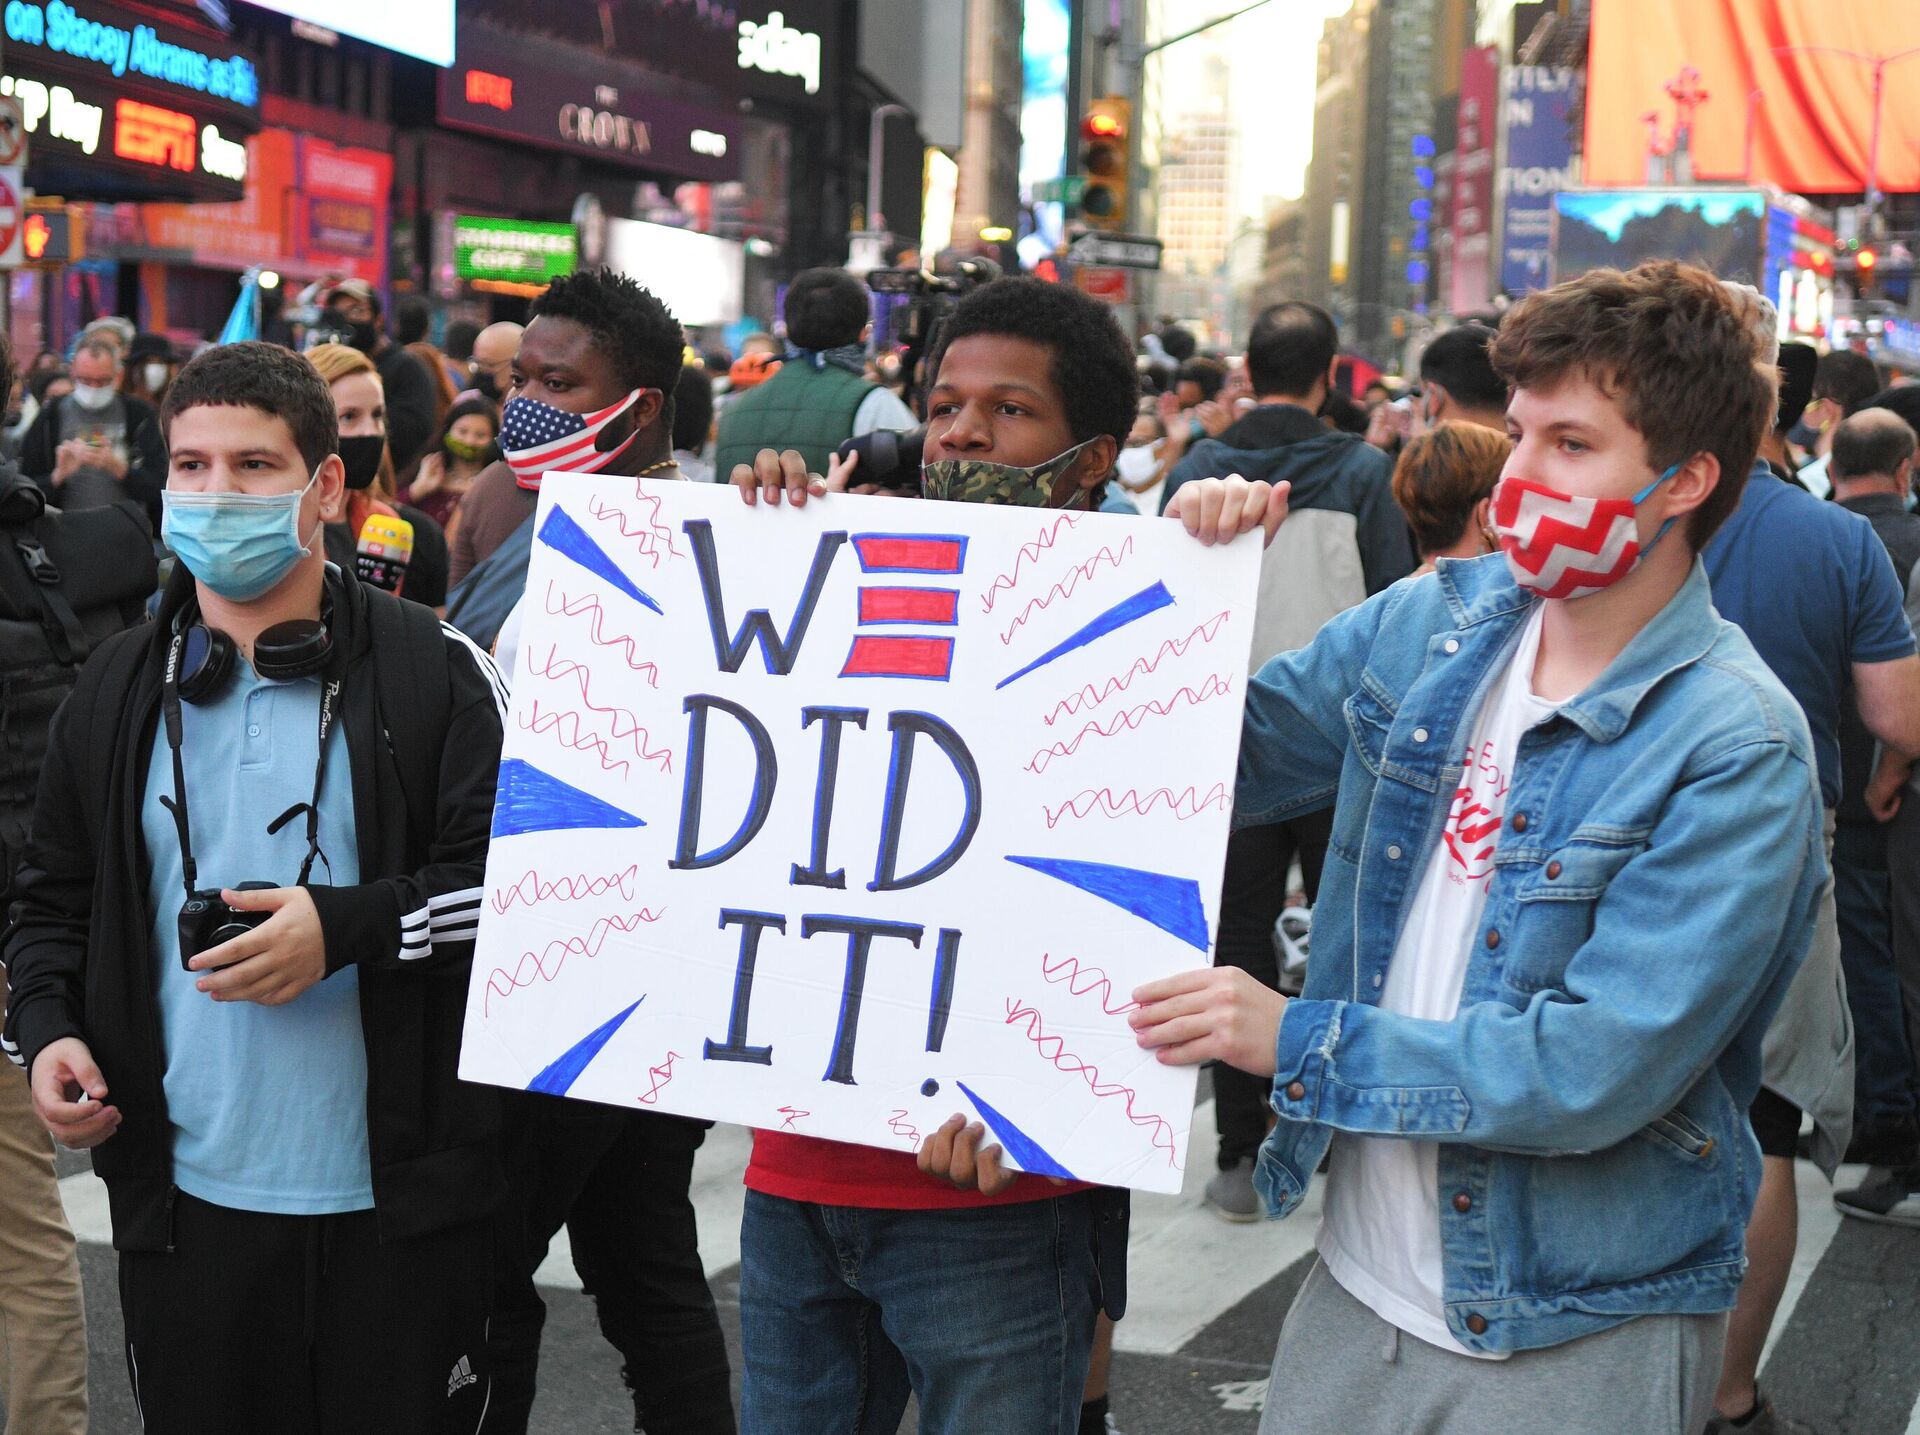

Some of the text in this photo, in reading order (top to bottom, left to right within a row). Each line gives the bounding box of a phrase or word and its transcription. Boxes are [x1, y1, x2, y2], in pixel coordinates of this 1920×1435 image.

[46, 0, 131, 77] Stacey
[129, 24, 208, 91] Abrams
[165, 634, 182, 684] Canon
[683, 520, 970, 683] WE
[320, 679, 340, 739] PowerShot
[668, 694, 982, 893] DID
[703, 908, 963, 1097] IT!
